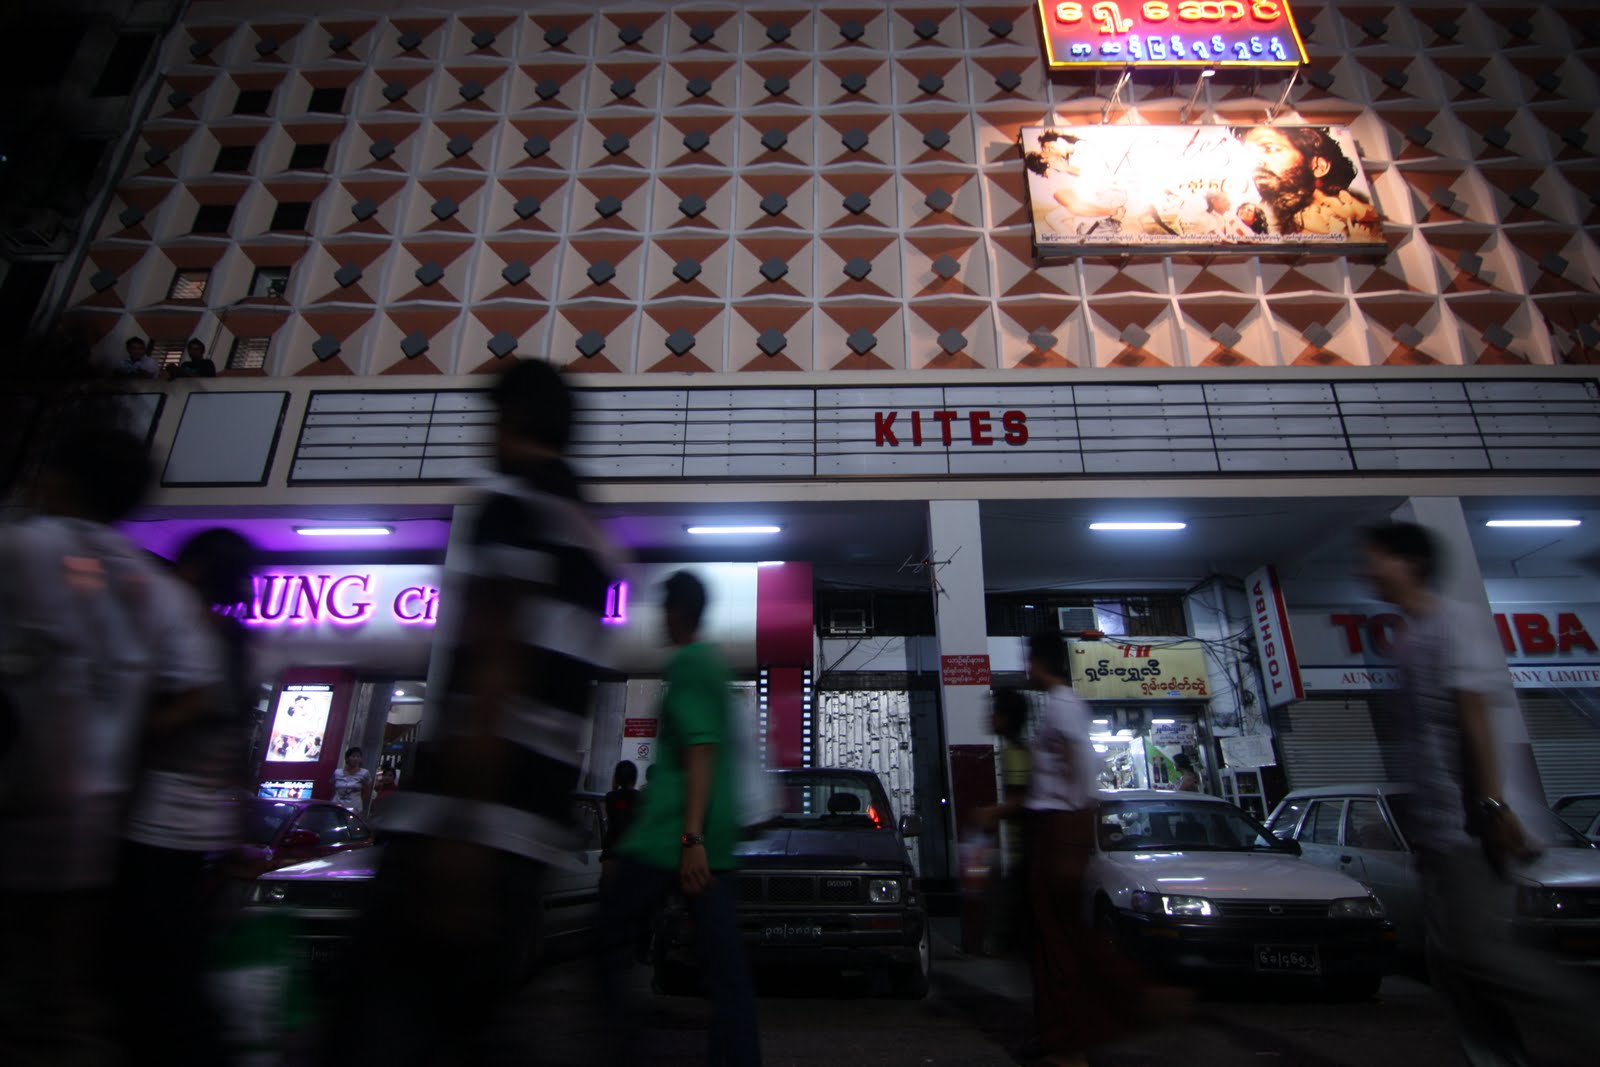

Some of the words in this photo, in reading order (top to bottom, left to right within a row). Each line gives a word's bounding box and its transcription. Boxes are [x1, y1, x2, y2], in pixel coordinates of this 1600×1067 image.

[875, 410, 1029, 447] KITES
[1252, 580, 1283, 695] TOSHIBA
[1331, 612, 1599, 654] TOIBA
[1547, 670, 1600, 682] LIMITE
